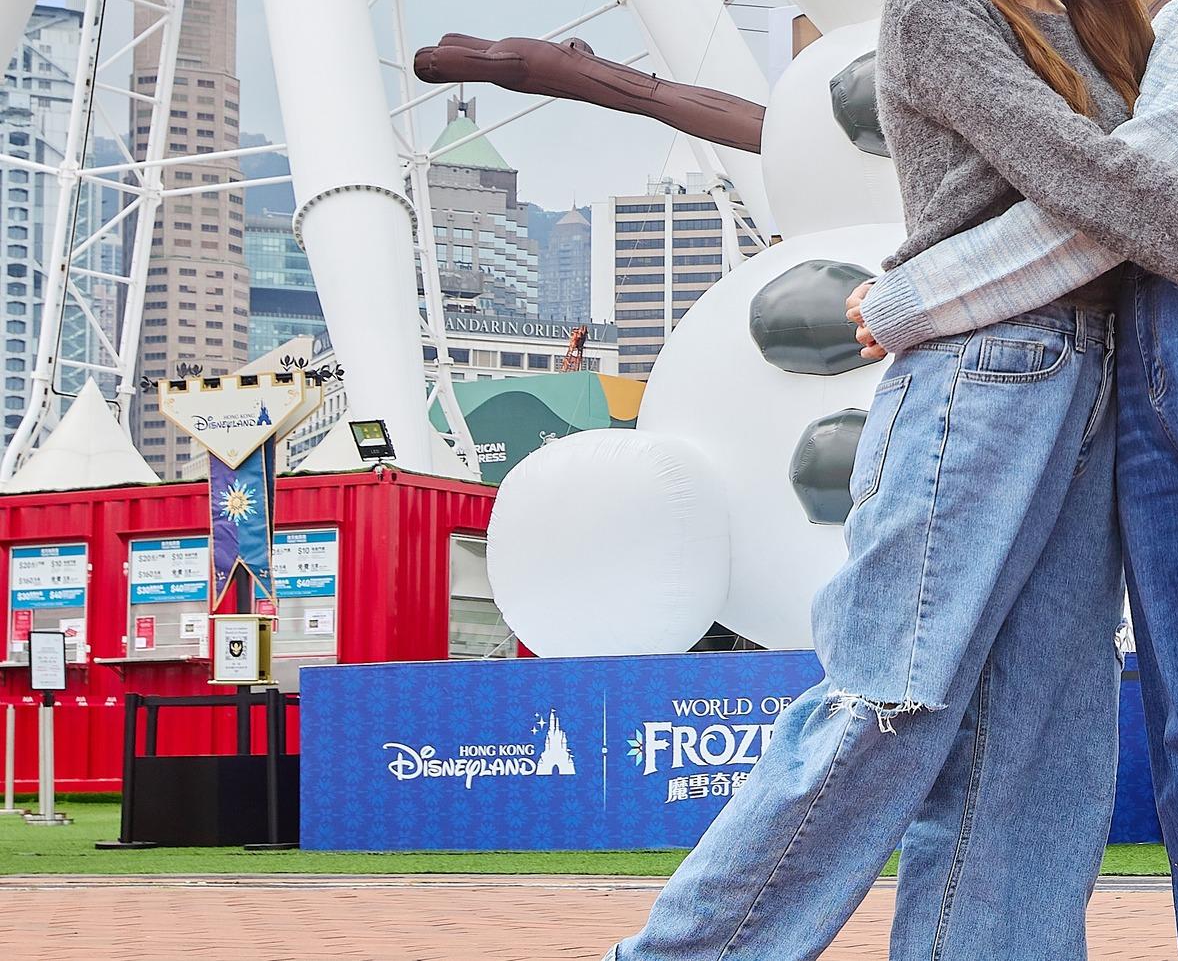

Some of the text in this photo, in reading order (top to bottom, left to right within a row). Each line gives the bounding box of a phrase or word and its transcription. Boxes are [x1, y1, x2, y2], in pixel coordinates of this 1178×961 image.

[445, 317, 601, 341] ANDARIN ORIENAL
[474, 442, 505, 454] RICAN
[479, 452, 507, 463] RESS
[672, 698, 753, 720] WORLD
[459, 744, 535, 757] HONG KONG
[642, 722, 775, 774] FROZ
